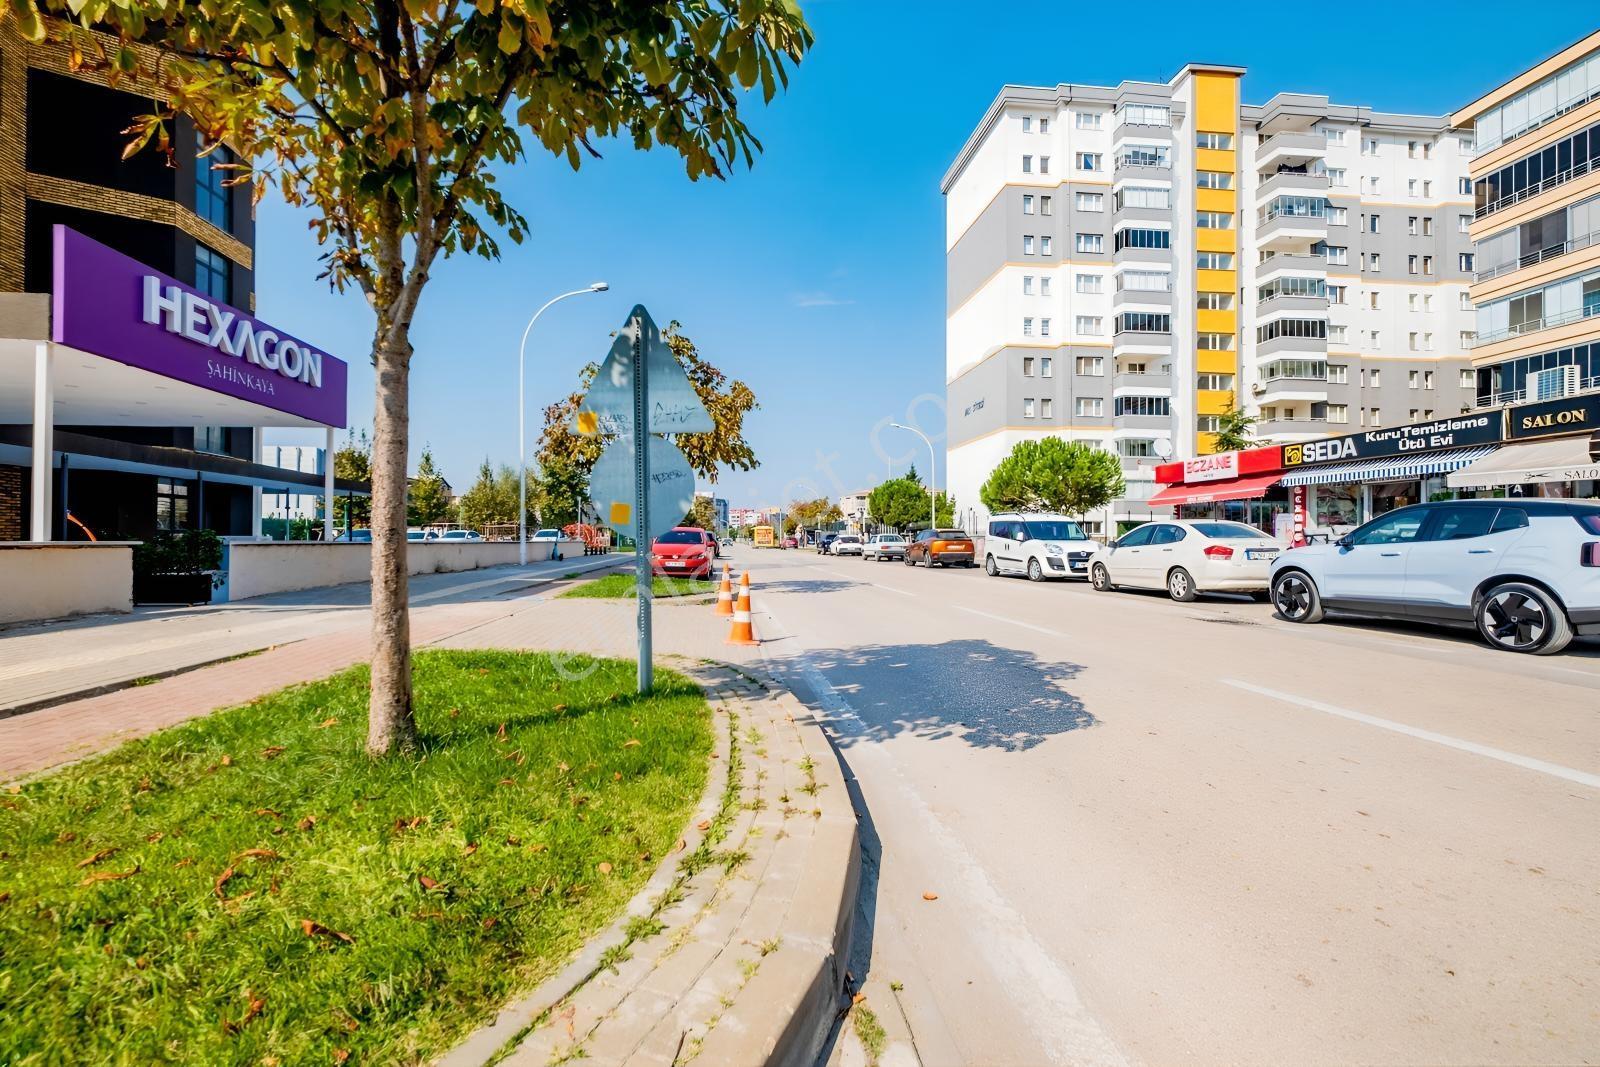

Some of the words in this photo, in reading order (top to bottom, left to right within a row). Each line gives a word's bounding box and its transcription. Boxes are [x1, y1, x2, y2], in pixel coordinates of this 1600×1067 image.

[143, 275, 322, 388] HEXAGON
[207, 359, 276, 396] ŞAHİNKAYA
[1365, 430, 1401, 443] Kuru
[1401, 416, 1489, 436] Temizleme
[1522, 408, 1587, 430] SALON
[1302, 437, 1358, 463] SEDA
[1398, 437, 1426, 451] Ütü
[1431, 433, 1454, 446] Evi
[1189, 455, 1232, 474] ECZANE
